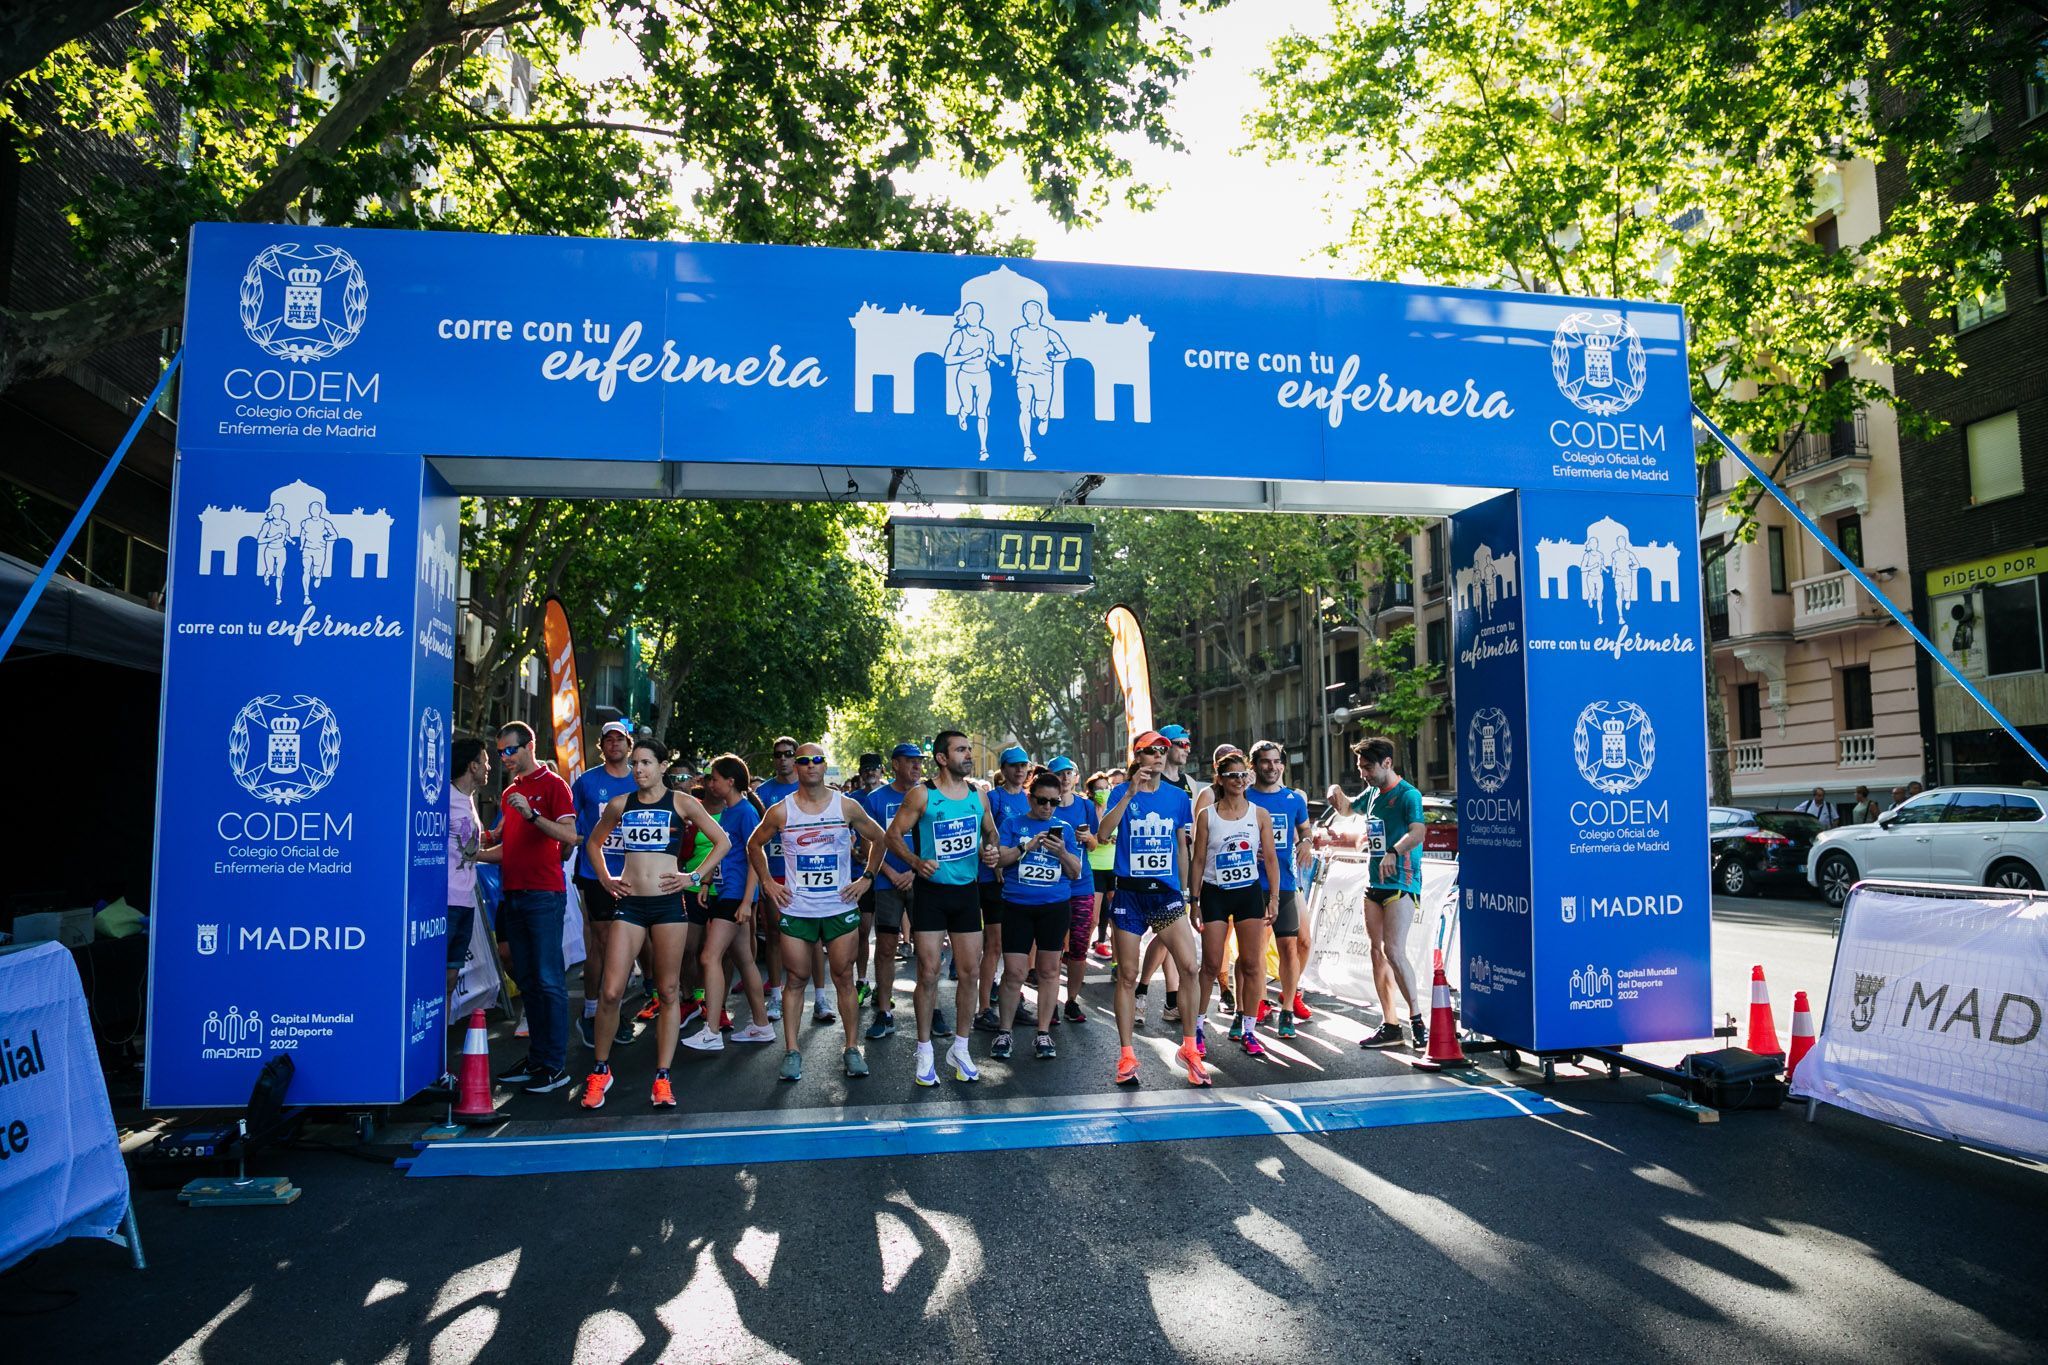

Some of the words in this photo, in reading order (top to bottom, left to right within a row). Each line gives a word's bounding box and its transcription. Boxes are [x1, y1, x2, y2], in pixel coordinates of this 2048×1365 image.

[437, 317, 513, 342] corre
[521, 319, 574, 344] con
[582, 318, 611, 345] tu
[541, 320, 829, 402] enfermera
[1184, 346, 1251, 371] corre
[1258, 349, 1304, 373] con
[1310, 350, 1334, 375] tu
[224, 368, 380, 403] CODEM
[1277, 354, 1514, 428] enfermera
[235, 404, 292, 421] Colegio
[295, 406, 340, 420] Oficial
[343, 407, 363, 420] de
[302, 423, 322, 437] de
[325, 424, 377, 438] Madrid
[1549, 420, 1665, 451] CODEM
[1562, 451, 1604, 466] Colegio
[1606, 453, 1640, 466] Oficial
[1641, 455, 1656, 466] de
[1614, 468, 1629, 480] de
[1631, 469, 1669, 481] Madrid
[1943, 565, 1997, 588] PÍDELO
[2003, 556, 2037, 575] POR
[177, 622, 215, 635] corre
[218, 622, 244, 635] con
[248, 620, 262, 635] tu
[266, 605, 404, 646] enfermera
[1480, 626, 1496, 637] corre
[1496, 623, 1508, 633] con
[1508, 621, 1516, 631] tu
[1528, 638, 1556, 650] corre
[1559, 638, 1577, 651] con
[1580, 637, 1591, 651] tu
[1593, 624, 1696, 660] enfermera
[1461, 634, 1519, 670] enfermera
[1466, 798, 1520, 821] CODEM
[1570, 800, 1668, 826] CODEM
[217, 812, 353, 841] CODEM
[415, 811, 447, 837] CODEM
[628, 828, 663, 843] 464
[1579, 829, 1615, 841] Colegio
[1616, 828, 1645, 839] Oficial
[1646, 827, 1659, 838] de
[228, 845, 278, 860] Colegio
[281, 845, 320, 858] Oficial
[322, 845, 340, 858] de
[941, 836, 972, 853] 339
[1622, 842, 1635, 852] de
[1637, 841, 1670, 852] Madrid
[287, 862, 305, 874] de
[308, 862, 352, 874] Madrid
[1137, 855, 1167, 868] 165
[802, 872, 834, 885] 175
[1024, 866, 1055, 880] 229
[1221, 867, 1252, 882] 393
[1480, 892, 1529, 914] MADRID
[1591, 894, 1683, 918] MADRID
[419, 917, 447, 940] MADRID
[239, 926, 366, 950] MADRID
[1617, 969, 1646, 979] Capital
[1646, 967, 1678, 977] Mundial
[1617, 980, 1630, 989] del
[1631, 979, 1663, 990] Deporte
[1617, 990, 1639, 1000] 2022
[1569, 999, 1613, 1010] MADRID
[271, 1013, 309, 1025] Capital
[311, 1013, 354, 1024] Mundial
[1901, 981, 2042, 1046] MAD
[270, 1027, 287, 1037] del
[289, 1027, 333, 1038] Deporte
[270, 1039, 298, 1049] 2022
[202, 1048, 262, 1059] MADRID
